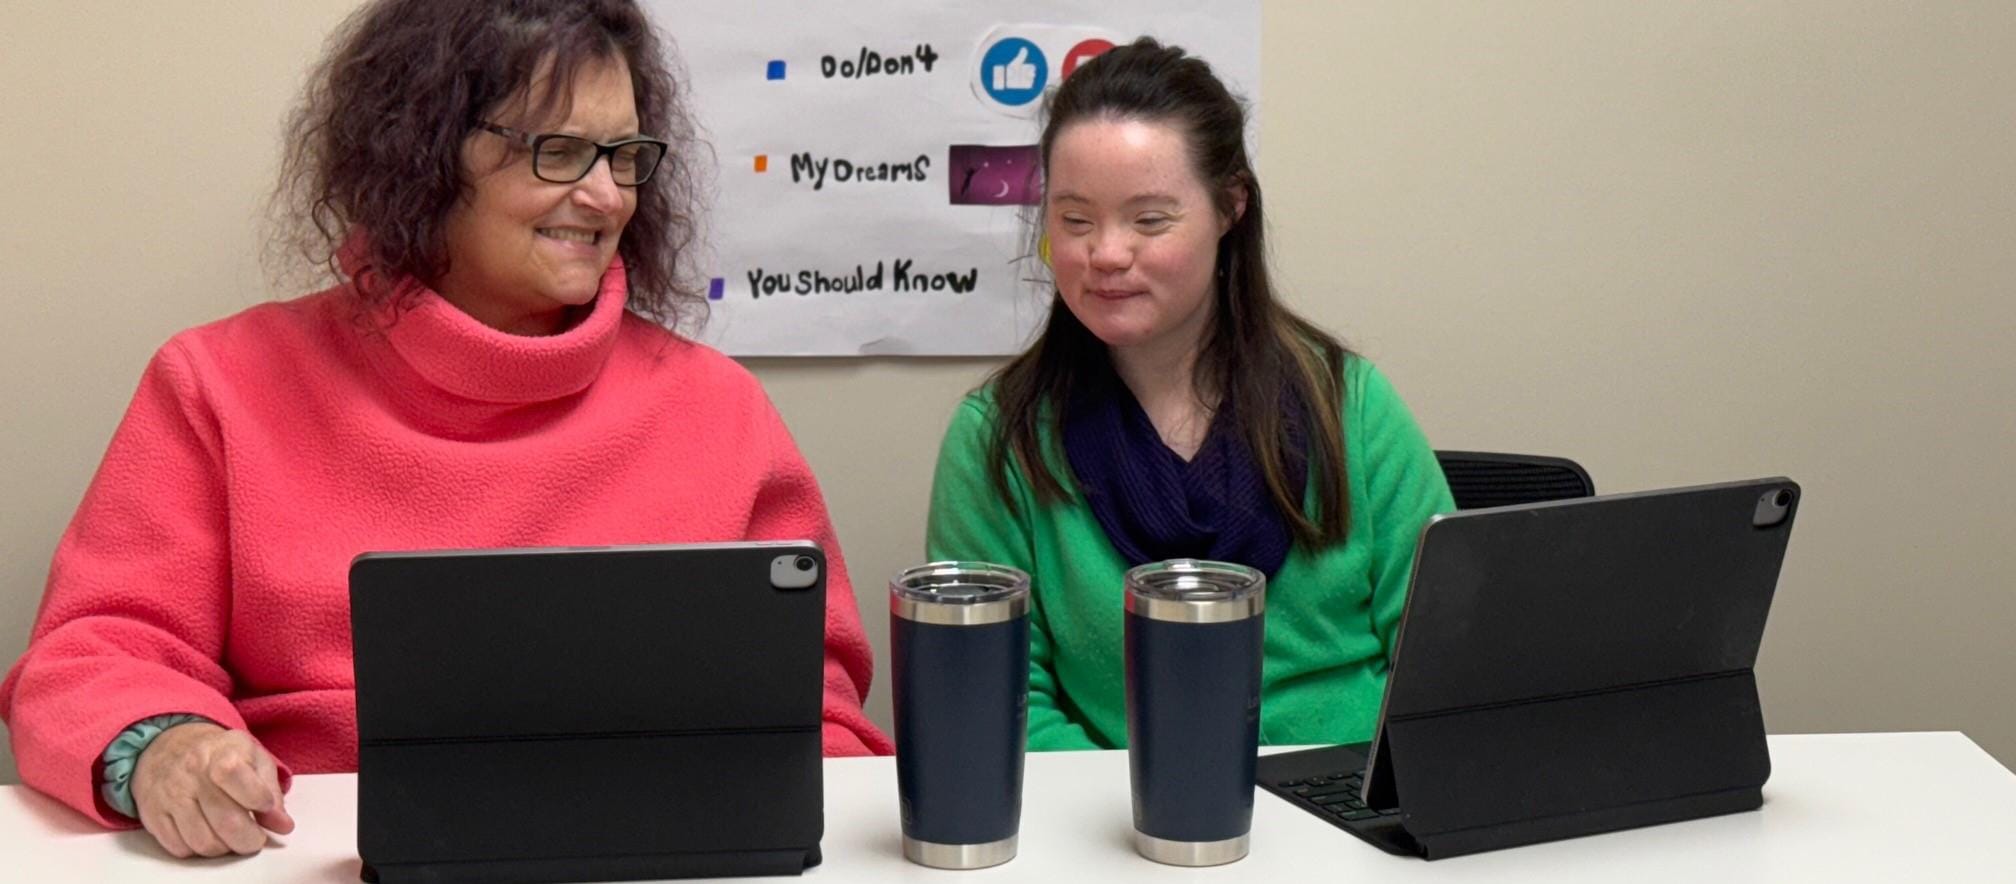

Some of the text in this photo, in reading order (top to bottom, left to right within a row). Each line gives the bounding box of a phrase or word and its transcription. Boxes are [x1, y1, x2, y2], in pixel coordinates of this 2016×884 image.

[790, 152, 829, 191] My
[747, 258, 978, 299] You Should Know
